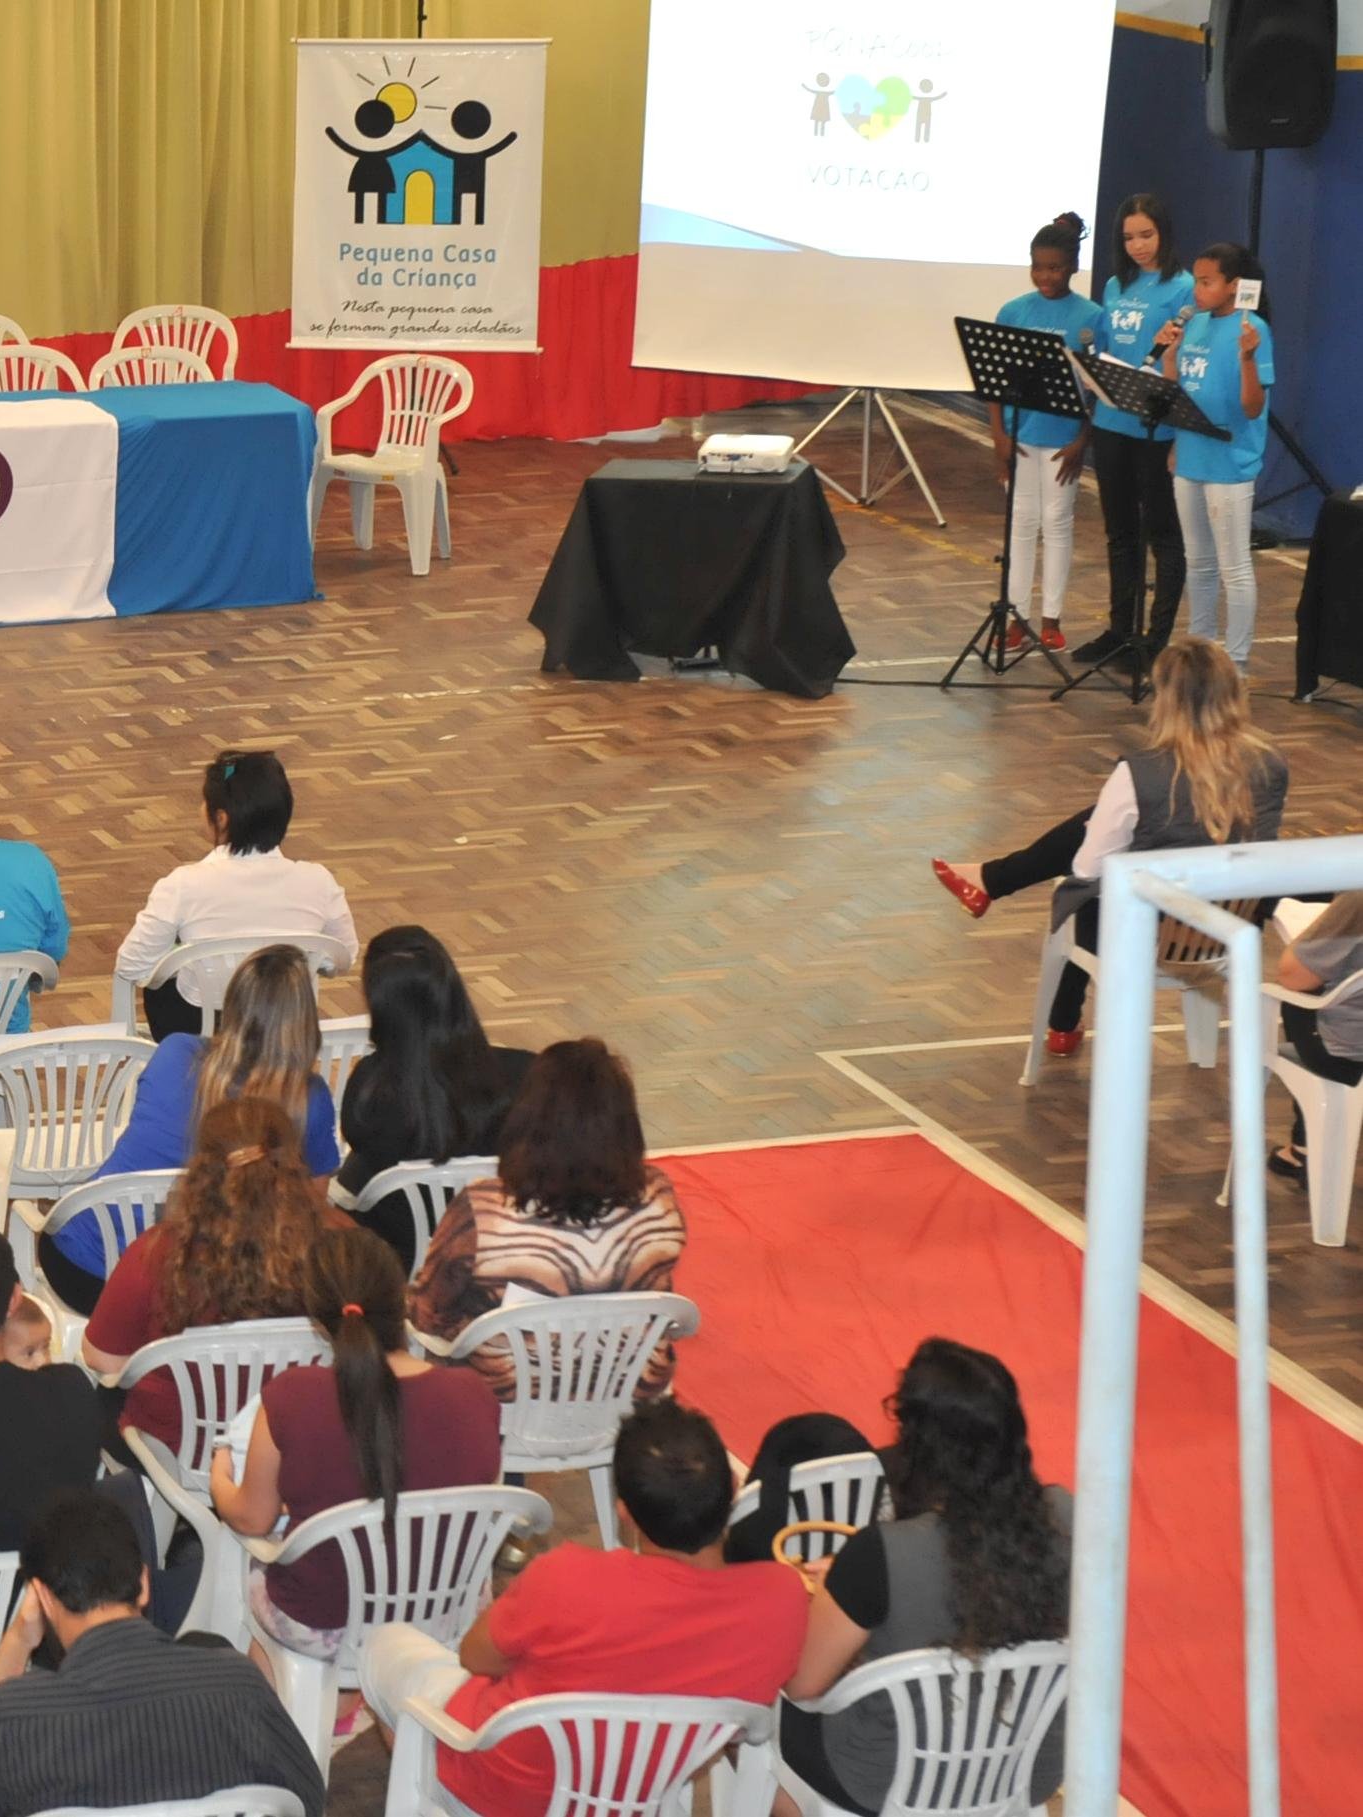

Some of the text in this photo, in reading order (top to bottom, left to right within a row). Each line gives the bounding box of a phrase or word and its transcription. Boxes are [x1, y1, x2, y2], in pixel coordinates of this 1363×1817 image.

[339, 243, 497, 266] Pequena Casa
[356, 267, 478, 289] da Criança
[341, 299, 493, 319] Nesta pequena casa
[309, 322, 325, 332] se
[325, 317, 385, 339] formam
[389, 320, 450, 338] grandes
